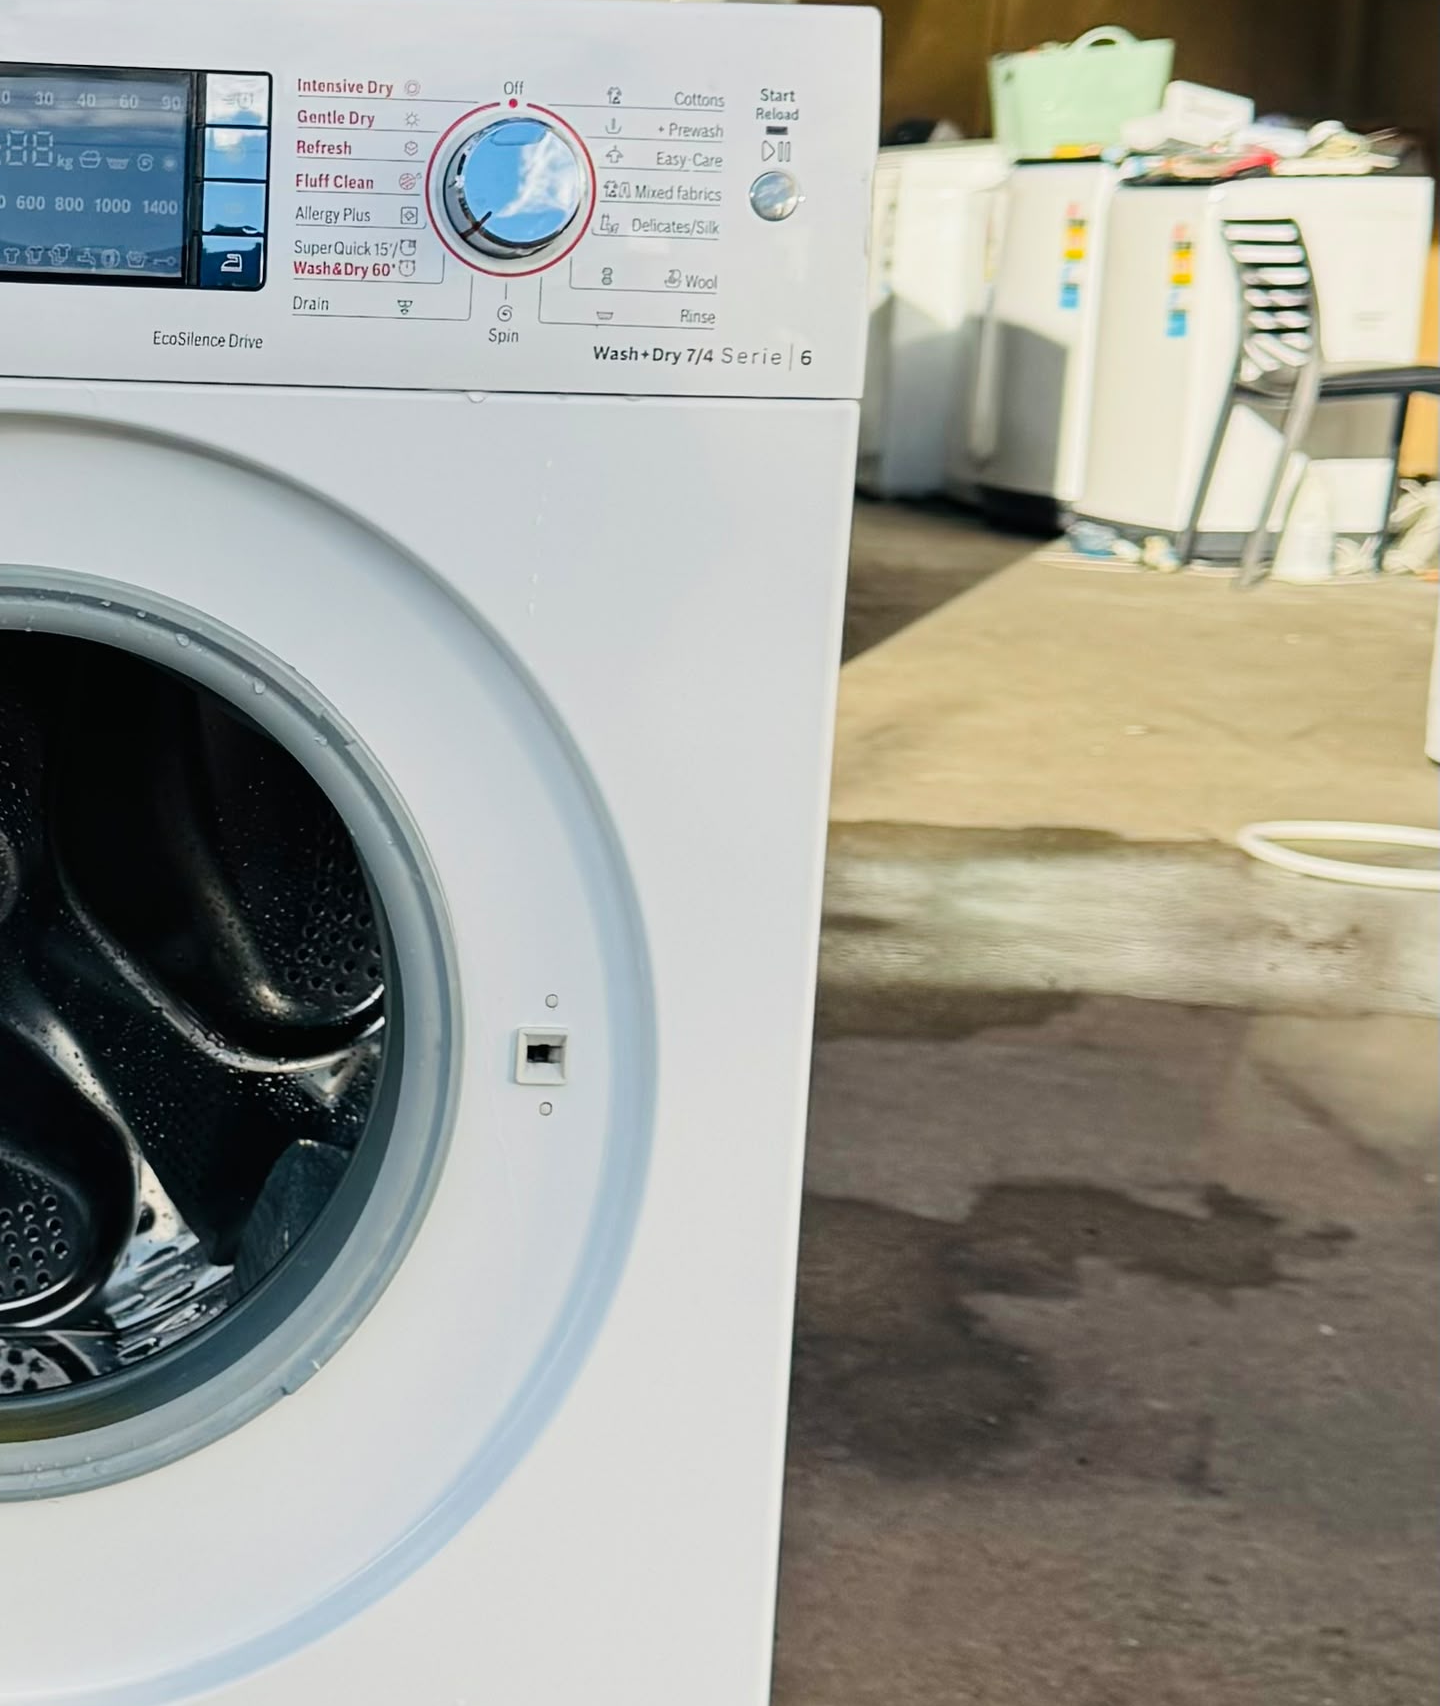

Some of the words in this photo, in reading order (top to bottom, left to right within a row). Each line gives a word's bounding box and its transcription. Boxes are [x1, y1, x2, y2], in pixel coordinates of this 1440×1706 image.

[297, 78, 364, 94] Intensive
[367, 81, 394, 98] Dry
[503, 81, 524, 95] Off
[760, 88, 796, 103] Start
[35, 92, 54, 106] 30
[77, 93, 97, 108] 40
[119, 95, 139, 109] 60
[161, 96, 181, 111] 90
[674, 91, 725, 108] Cottons
[297, 110, 345, 126] Gentle
[349, 111, 376, 129] Dry
[755, 107, 799, 121] Reload
[668, 123, 724, 139] Prewash
[296, 140, 352, 156] Refresh
[58, 154, 74, 171] kg
[656, 151, 723, 169] Easy-Care
[295, 174, 329, 189] Fluff
[332, 174, 374, 190] Clean
[635, 184, 673, 201] Mixed
[676, 186, 722, 202] fabrics
[15, 195, 46, 211] 600
[54, 196, 85, 212] 800
[94, 198, 132, 214] 1000
[142, 199, 178, 215] 1400
[295, 206, 340, 225] Allergy
[343, 208, 371, 223] Plus
[632, 218, 721, 236] Delicates/Silk
[293, 261, 369, 280] Wash&Dry
[685, 274, 718, 290] Wool
[292, 295, 329, 311] Drain
[680, 309, 716, 325] Rinse
[153, 330, 226, 348] EcoSilence
[229, 333, 264, 350] Drive
[488, 328, 519, 345] Spin
[593, 346, 682, 366] Wash+Dry
[686, 348, 714, 366] 7/4
[721, 347, 782, 366] Serie
[800, 350, 812, 366] 6
